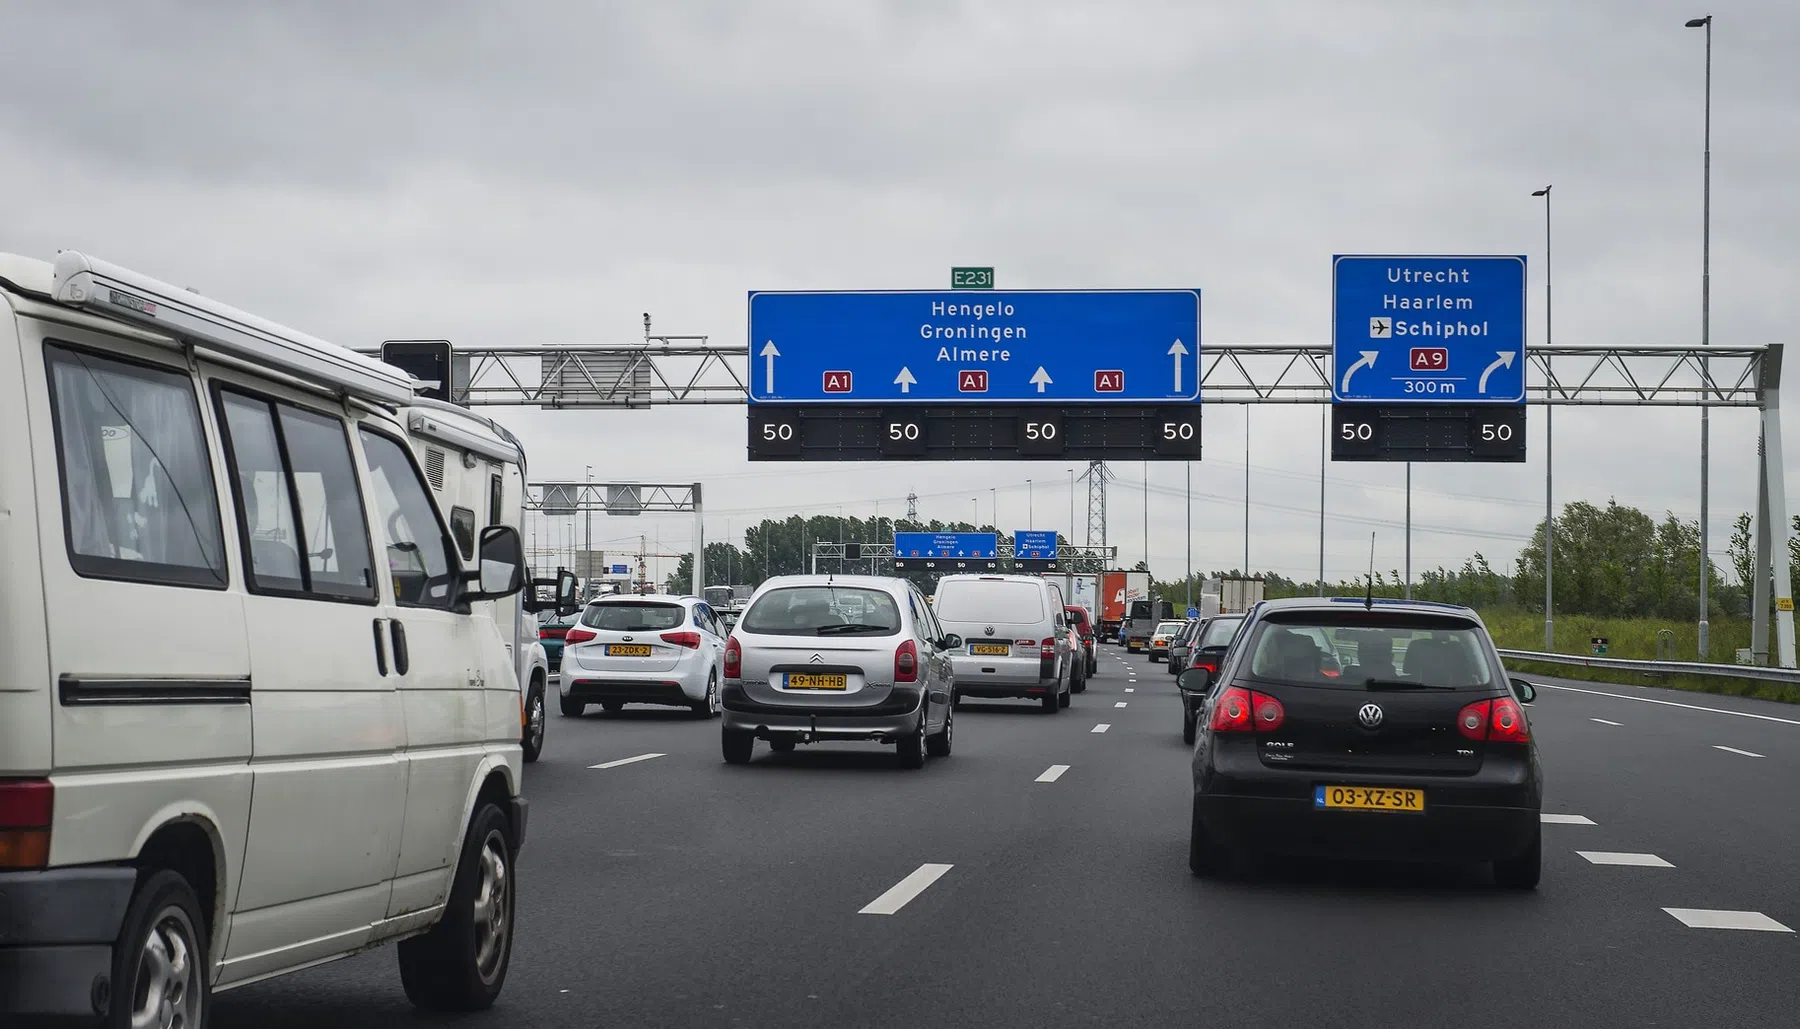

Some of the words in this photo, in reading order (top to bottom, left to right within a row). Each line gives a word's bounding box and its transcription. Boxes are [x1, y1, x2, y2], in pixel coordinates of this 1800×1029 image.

[954, 271, 991, 285] E231
[1387, 268, 1470, 283] Utrecht
[1383, 294, 1473, 310] Haarlem
[932, 302, 1015, 320] Hengelo
[920, 323, 1026, 343] Groningen
[1395, 320, 1488, 339] Schiphol
[936, 346, 1011, 362] Almere
[1415, 352, 1443, 366] A9
[827, 375, 848, 389] A1
[963, 375, 984, 388] A1
[1099, 375, 1119, 388] A1
[1404, 381, 1436, 394] 300
[763, 424, 793, 441] 50
[889, 424, 919, 440] 50
[1026, 423, 1056, 440] 50
[1163, 423, 1194, 440] 50
[1342, 423, 1373, 441] 50
[1481, 424, 1512, 441] 50
[612, 646, 648, 655] 23-ZDK-2
[976, 645, 1006, 653] VG-516-Z
[790, 675, 844, 688] 49-NH-HB
[1332, 788, 1416, 808] 03-XZ-SR
